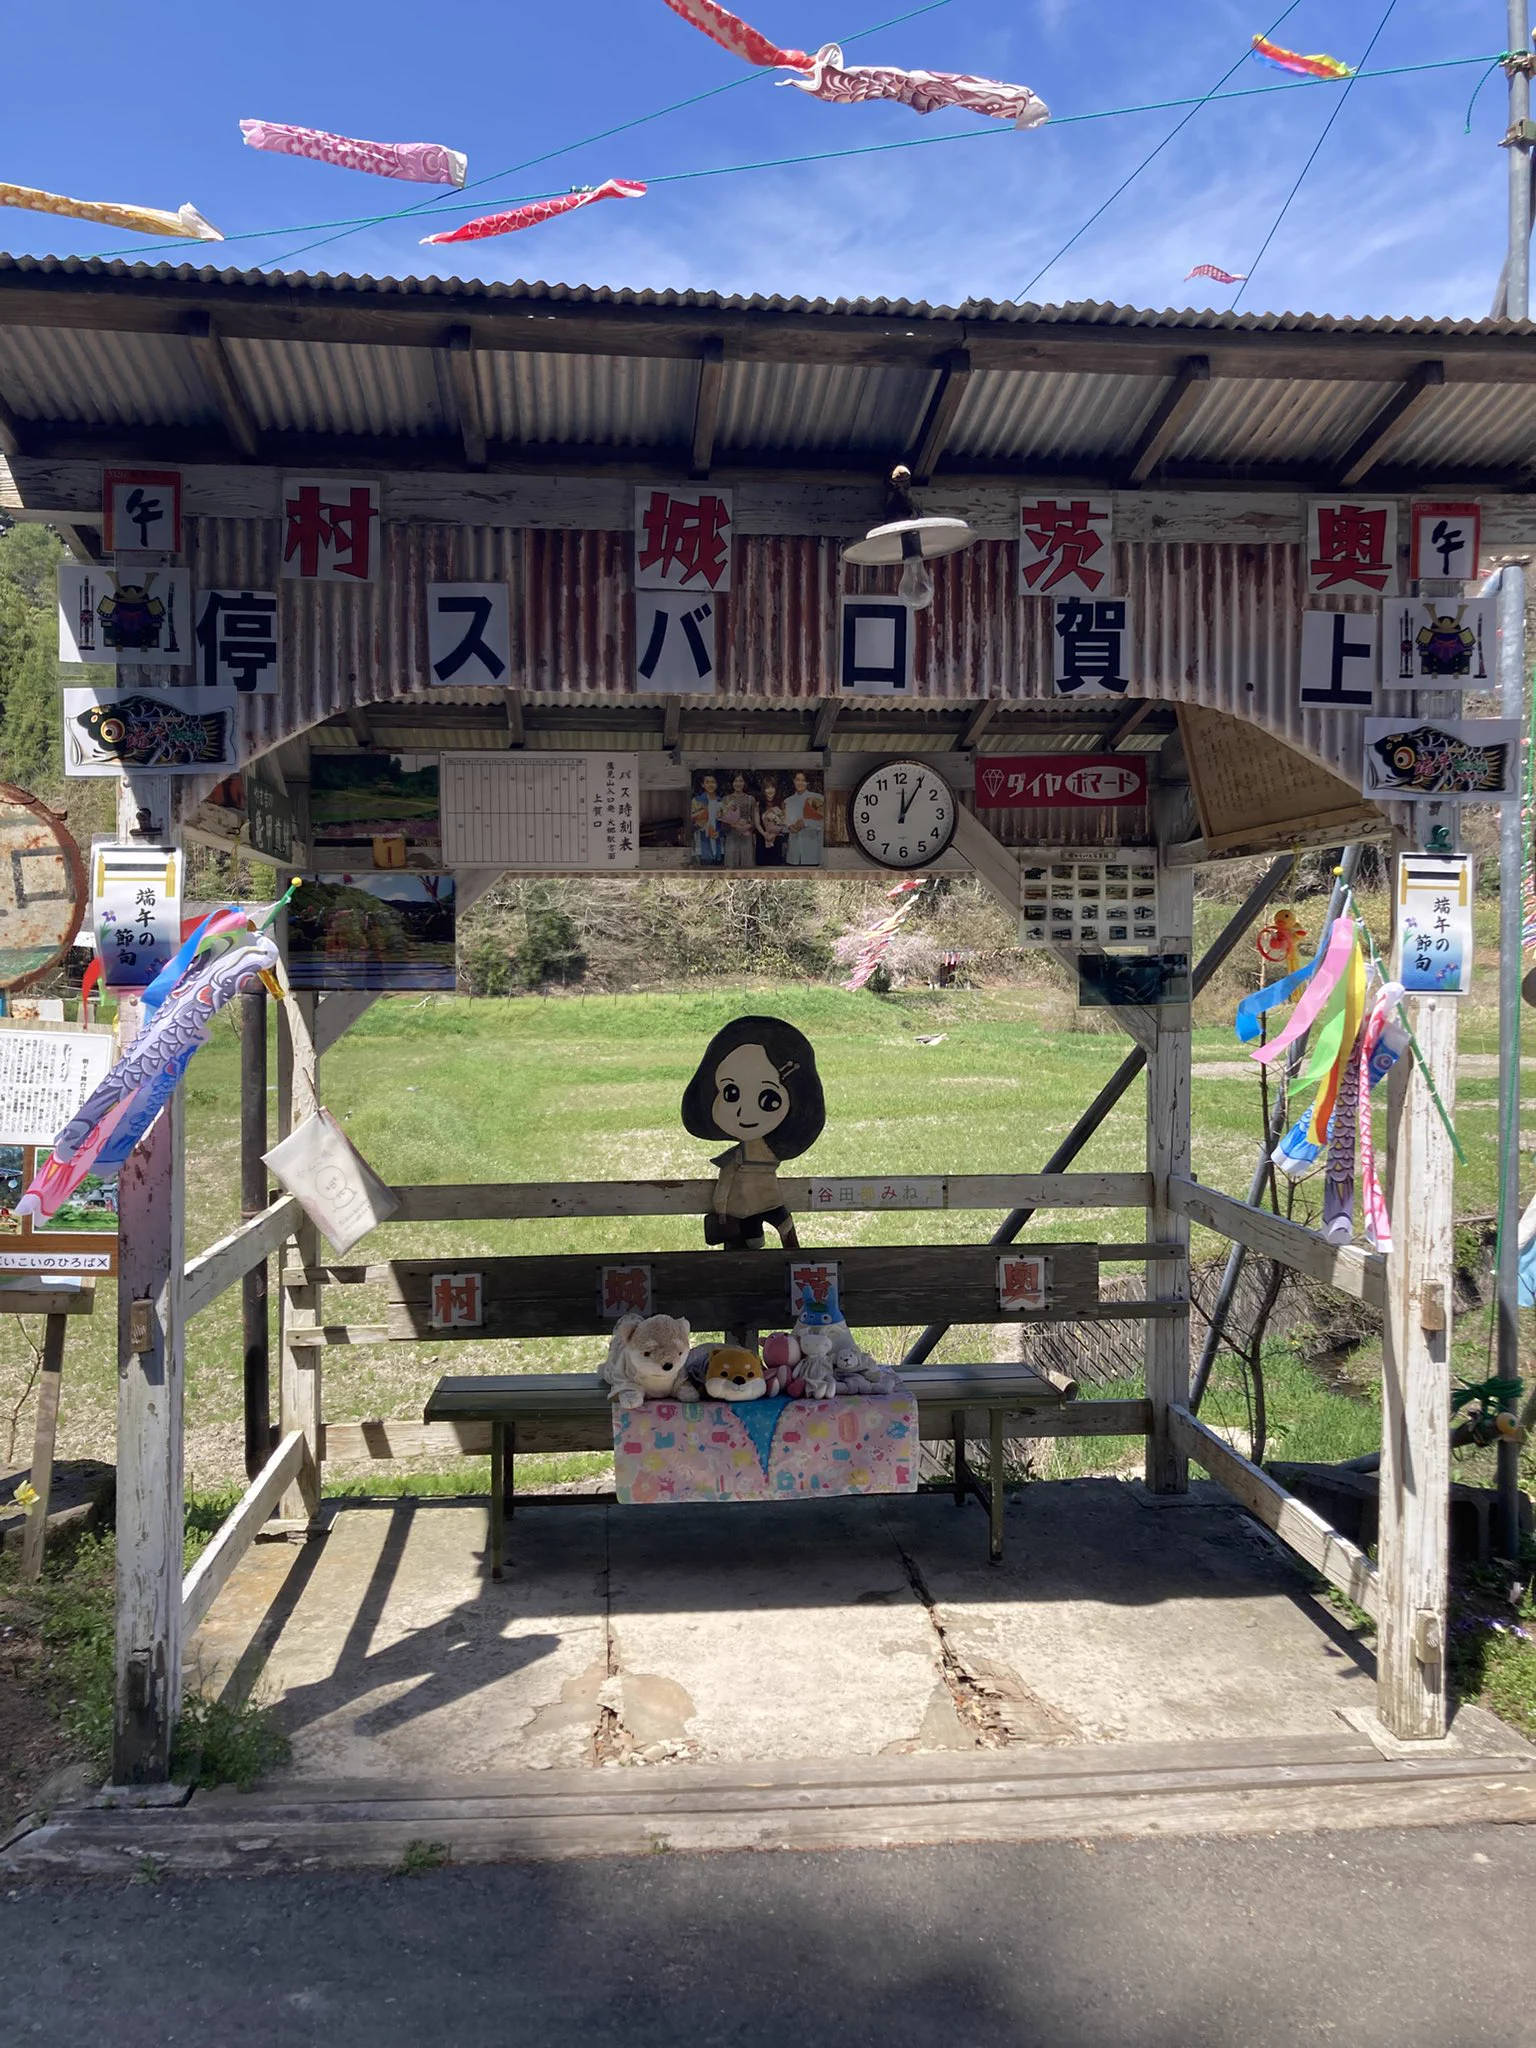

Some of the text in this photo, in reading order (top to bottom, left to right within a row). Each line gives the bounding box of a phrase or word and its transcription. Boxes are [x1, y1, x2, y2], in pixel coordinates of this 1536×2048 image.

[126, 488, 164, 547] 午
[284, 486, 1393, 592] 奥 茨 城 村
[1432, 520, 1465, 575] 午
[196, 591, 277, 692] 停
[433, 596, 506, 680] ス
[638, 603, 712, 679] バ
[1055, 597, 1130, 693] 賀
[1301, 614, 1372, 705] 上
[877, 780, 887, 791] 11
[894, 773, 907, 784] 12
[929, 790, 938, 801] 2
[592, 794, 603, 828] 上賀口
[618, 769, 633, 851] バス時刻表
[861, 812, 870, 823] 9
[864, 794, 878, 806] 10
[936, 808, 944, 820] 3
[867, 830, 876, 841] 8
[881, 843, 890, 854] 7
[899, 847, 908, 858] 6
[918, 841, 926, 852] 5
[930, 827, 940, 839] 4
[135, 888, 156, 946] 端午の
[1432, 897, 1450, 953] 端午の
[116, 928, 137, 966] 節句
[1414, 935, 1433, 972] 節句
[433, 1279, 480, 1322] 村
[605, 1268, 648, 1311] 城
[1001, 1262, 1040, 1303] 奥
